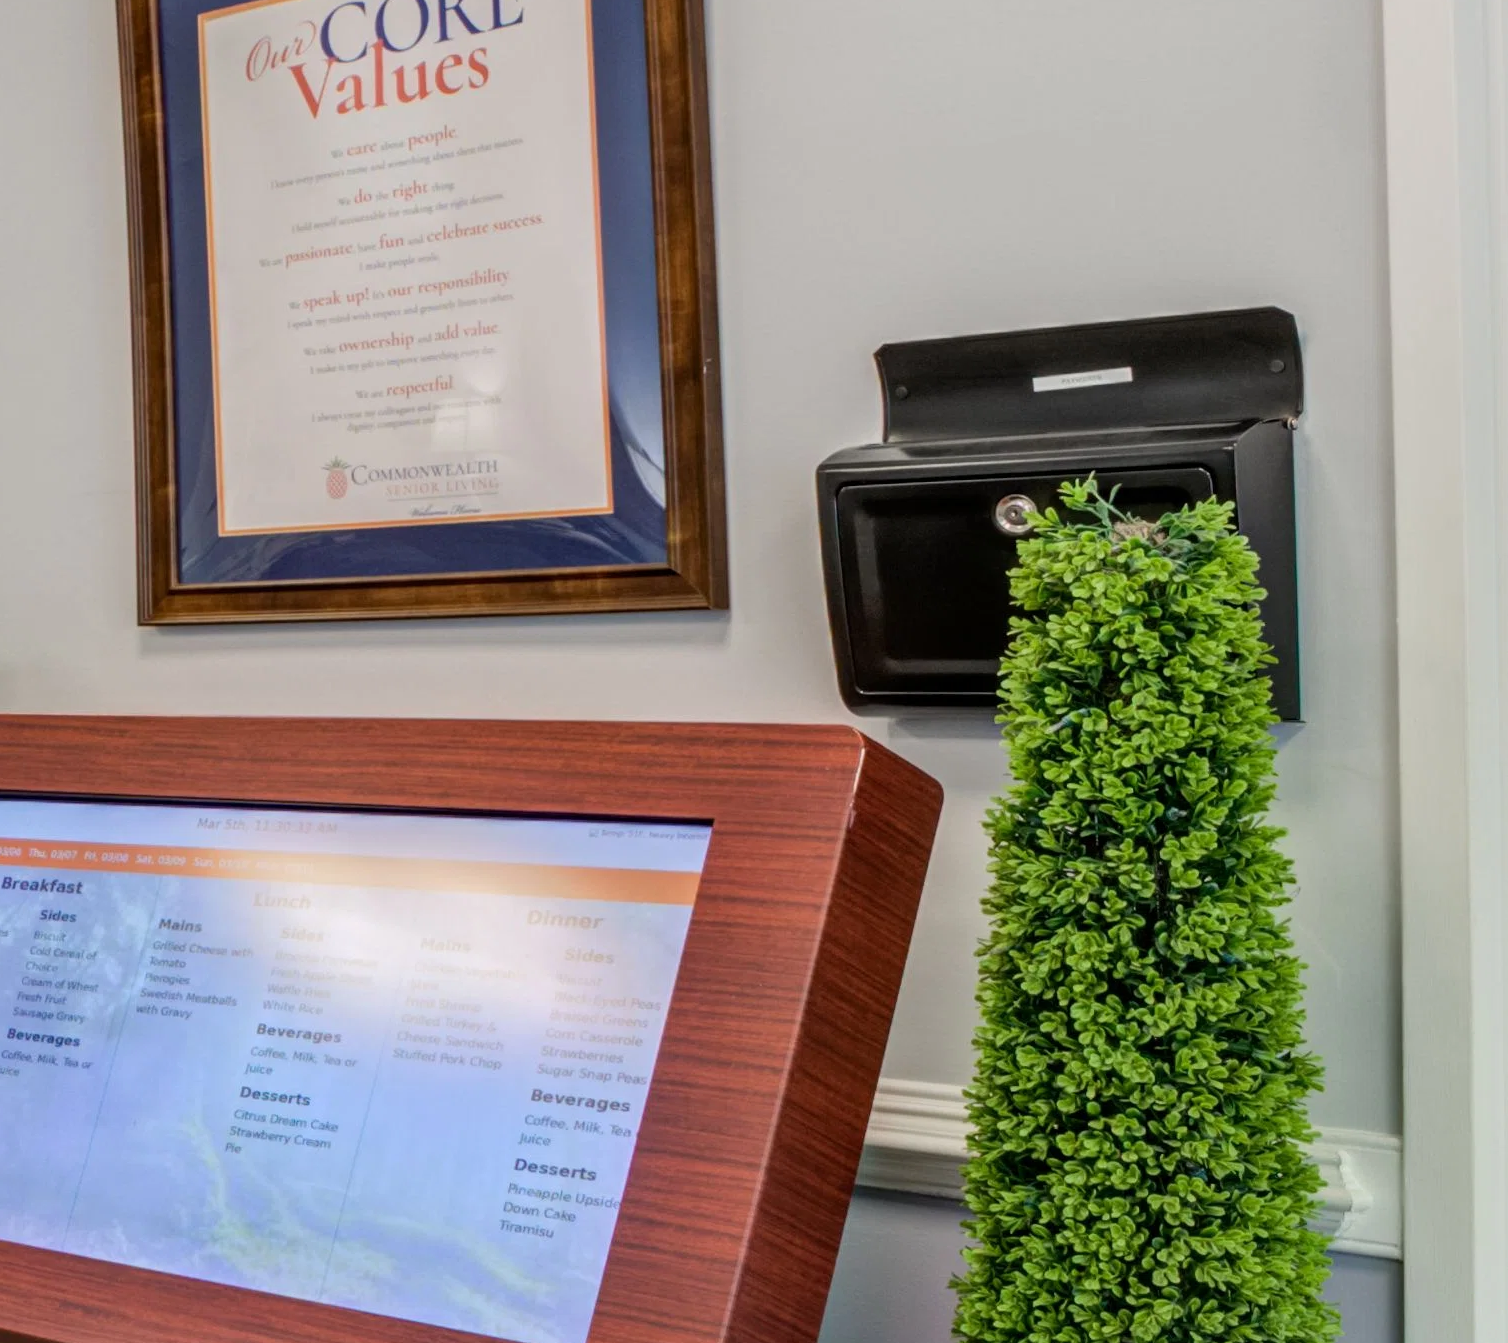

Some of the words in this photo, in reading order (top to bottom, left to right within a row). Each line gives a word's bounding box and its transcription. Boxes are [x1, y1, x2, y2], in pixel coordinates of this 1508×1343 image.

[245, 20, 317, 81] Our
[287, 38, 489, 119] Values
[346, 142, 377, 156] care
[354, 188, 372, 204] do
[392, 180, 428, 202] right
[379, 234, 404, 250] fun
[426, 220, 489, 243] celebrate
[303, 290, 343, 313] speak
[346, 287, 370, 307] up!
[388, 284, 414, 298] our
[338, 331, 415, 354] ownership
[434, 322, 459, 341] add
[350, 459, 498, 486] COMMONWEALTH
[385, 481, 440, 497] SENIOR
[446, 476, 500, 492] LIVING
[1, 876, 83, 895] Breakfast
[252, 892, 312, 909] Lunch
[39, 909, 77, 923] Sides
[159, 918, 203, 933] Mains
[527, 910, 605, 930] Dinner
[34, 930, 67, 942] Biscuit
[420, 937, 472, 953] Mains
[30, 945, 51, 957] Cold
[53, 948, 84, 959] Cereal
[86, 950, 97, 960] of
[153, 940, 186, 952] Grilled
[189, 942, 228, 956] Cheese
[231, 947, 254, 958] with
[564, 948, 615, 965] Sides
[25, 961, 59, 972] Choice
[149, 956, 186, 969] Tomato
[21, 976, 52, 988] Cream
[55, 978, 65, 989] of
[67, 981, 99, 993] Wheat
[17, 991, 42, 1003] Fresh
[44, 993, 67, 1005] Fruit
[140, 988, 183, 1001] Swedish
[185, 992, 237, 1007] Meatballs
[13, 1006, 54, 1021] Sausage
[56, 1010, 85, 1024] Gravy
[135, 1004, 158, 1016] with
[161, 1007, 193, 1021] Gravy
[7, 1028, 81, 1047] Beverages
[256, 1023, 342, 1044] Beverages
[396, 1030, 440, 1046] Cheese
[445, 1034, 505, 1052] Sandwich
[545, 1027, 576, 1041] Corn
[579, 1029, 644, 1047] Casserole
[63, 1057, 79, 1068] Tea
[81, 1060, 93, 1069] or
[323, 1055, 341, 1066] Tea
[344, 1058, 358, 1067] or
[392, 1047, 436, 1063] Stuffed
[439, 1052, 466, 1066] Pork
[469, 1055, 503, 1071] Chop
[540, 1045, 624, 1064] Strawberries
[244, 1063, 274, 1075] Juice
[537, 1064, 574, 1079] Sugar
[579, 1068, 612, 1083] Snap
[617, 1071, 648, 1085] Peas
[239, 1086, 311, 1106] Desserts
[531, 1088, 632, 1112] Beverages
[233, 1109, 267, 1123] Citrus
[269, 1114, 307, 1128] Dream
[310, 1119, 339, 1133] Cake
[524, 1114, 569, 1131] Coffee,
[609, 1124, 632, 1138] Tea
[229, 1125, 290, 1145] Strawberry
[293, 1135, 332, 1149] Cream
[518, 1133, 552, 1147] Juice
[225, 1142, 242, 1154] Pie
[514, 1158, 597, 1181] Desserts
[508, 1182, 572, 1203] Pineapple
[575, 1193, 621, 1209] Upside
[503, 1201, 540, 1216] Down
[544, 1207, 576, 1223] Cake
[499, 1219, 555, 1239] Tiramisu
